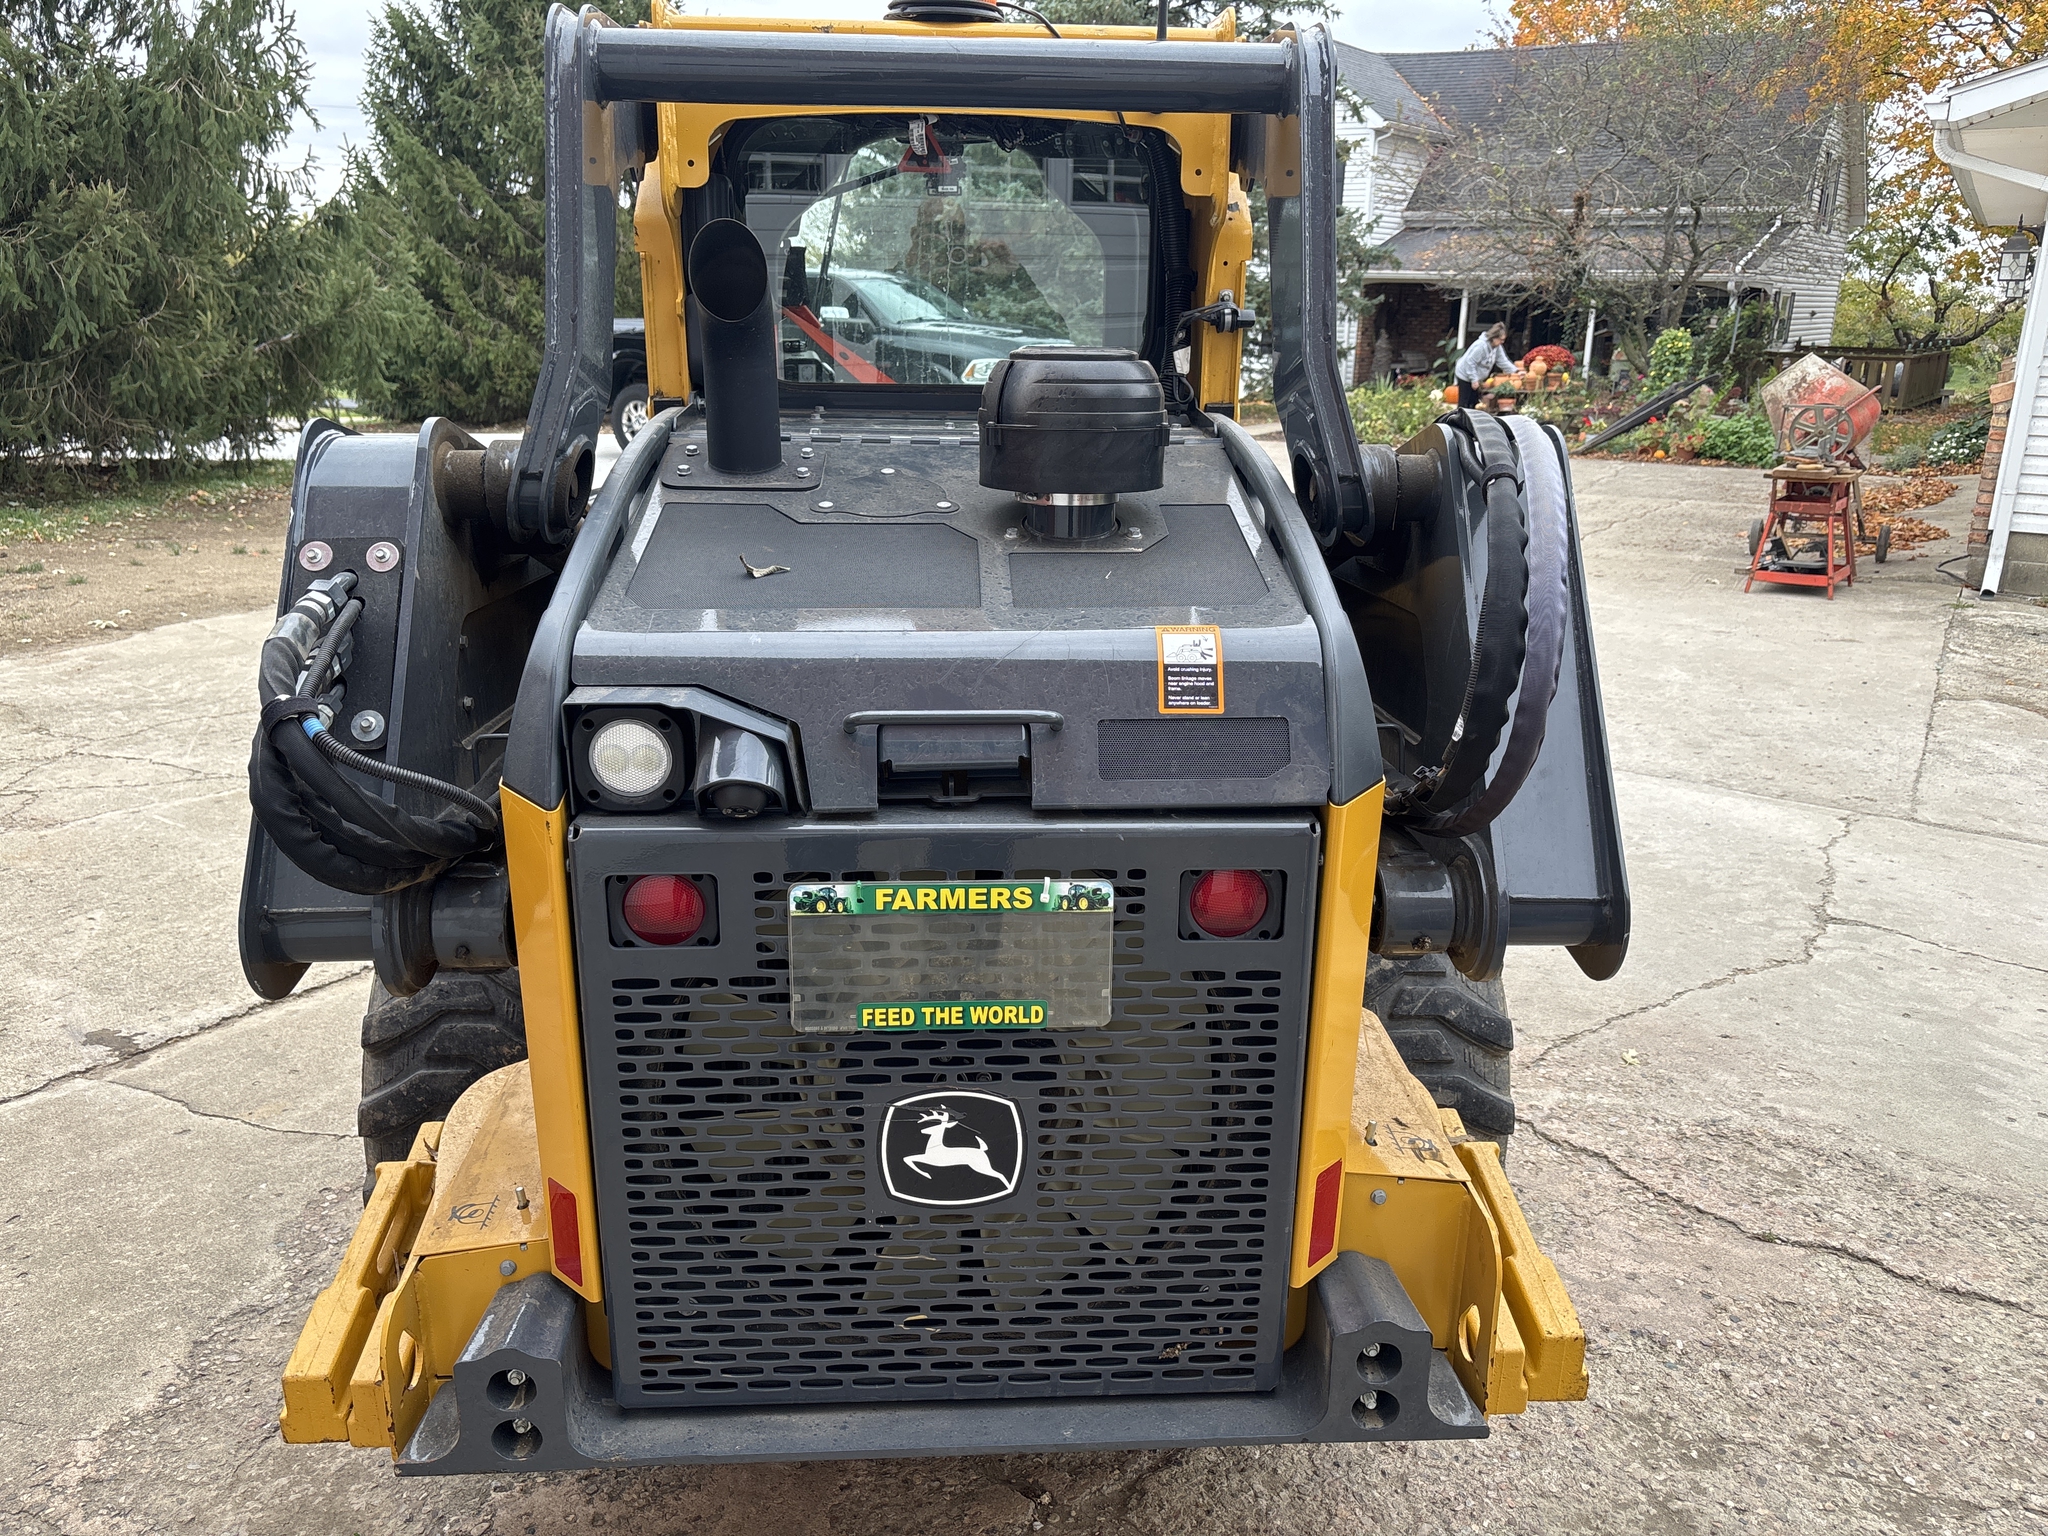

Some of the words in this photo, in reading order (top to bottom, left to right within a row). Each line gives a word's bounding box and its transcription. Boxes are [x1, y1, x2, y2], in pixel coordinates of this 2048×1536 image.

[875, 887, 1034, 910] FARMERS
[862, 1007, 915, 1027] FEED
[921, 1006, 964, 1026] THE
[970, 1005, 1044, 1025] WORLD
